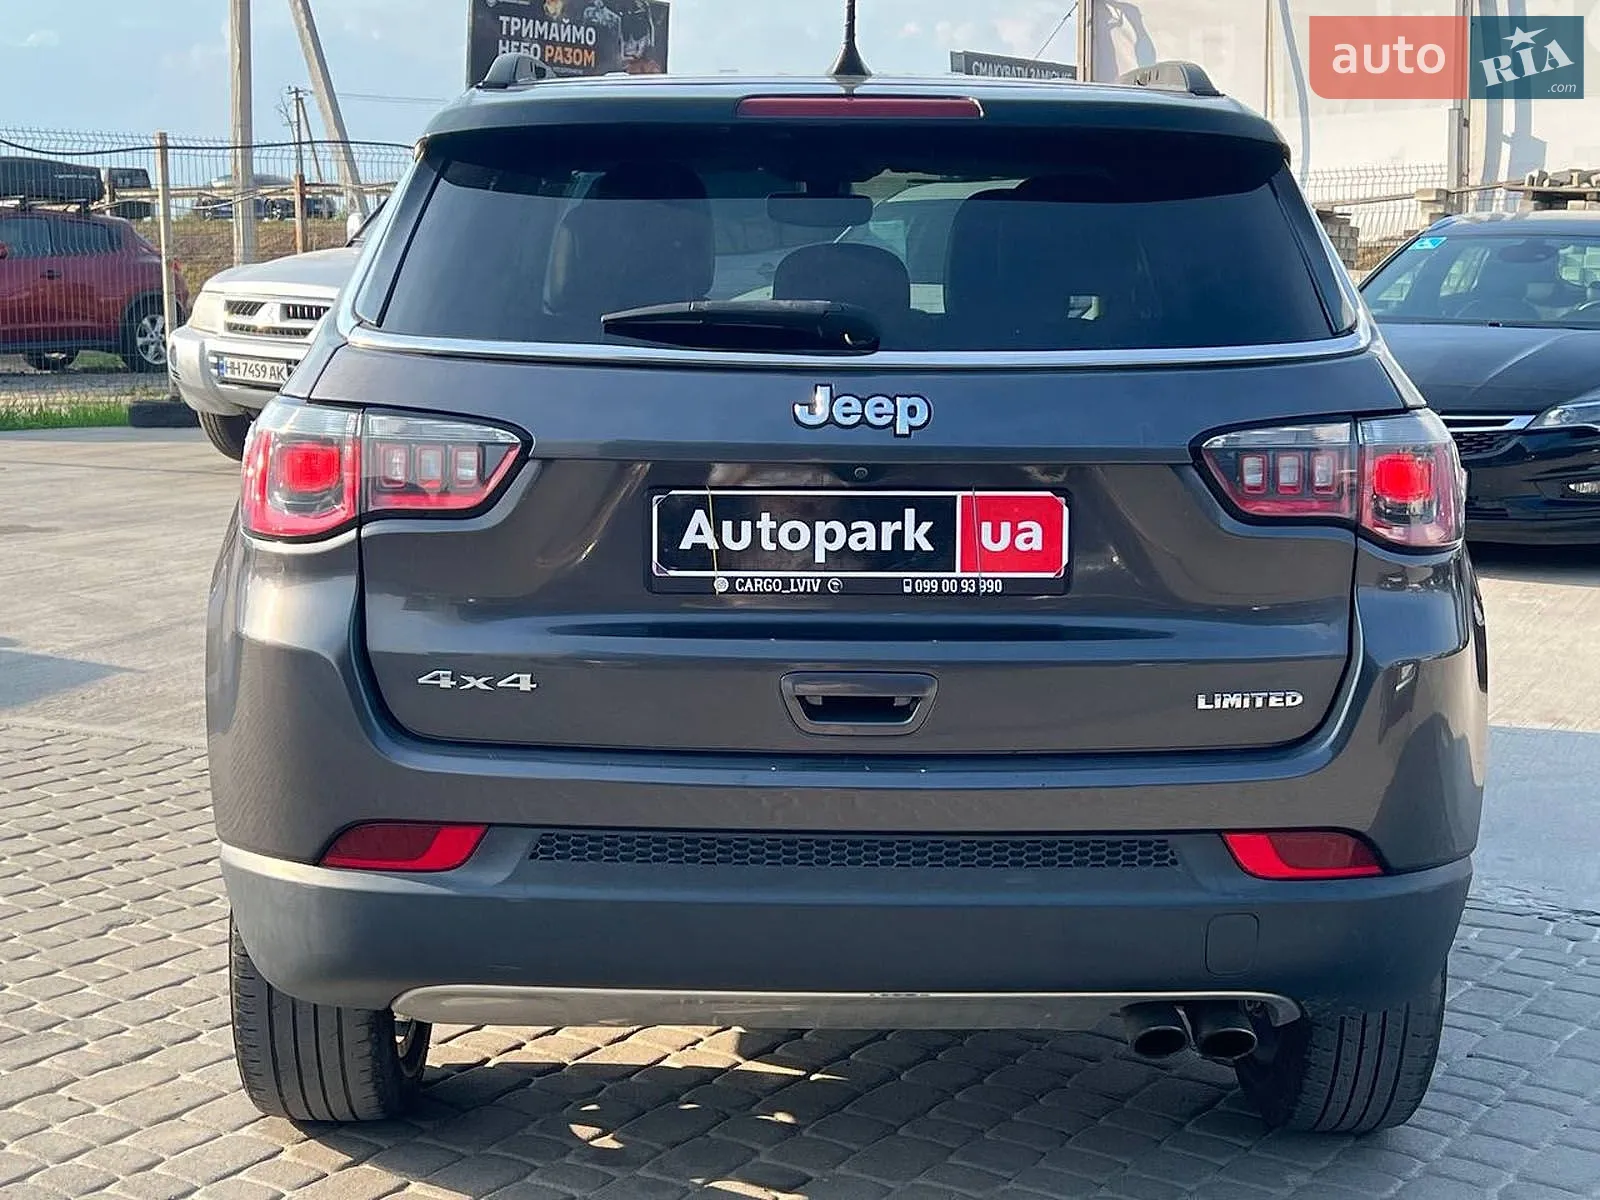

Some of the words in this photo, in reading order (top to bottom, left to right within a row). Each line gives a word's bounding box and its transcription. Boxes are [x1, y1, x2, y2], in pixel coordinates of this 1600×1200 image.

[498, 15, 597, 46] ТРИМАЙМО
[544, 45, 596, 68] РАЗОМ
[792, 384, 930, 436] Jeep
[678, 508, 934, 564] Autopark
[980, 519, 1043, 552] ua
[735, 578, 821, 593] CARGO_LVIV
[914, 578, 939, 593] 099
[941, 578, 958, 593] 00
[960, 578, 976, 593] 93
[417, 670, 538, 692] 4x4
[1197, 691, 1304, 710] LIMITED
